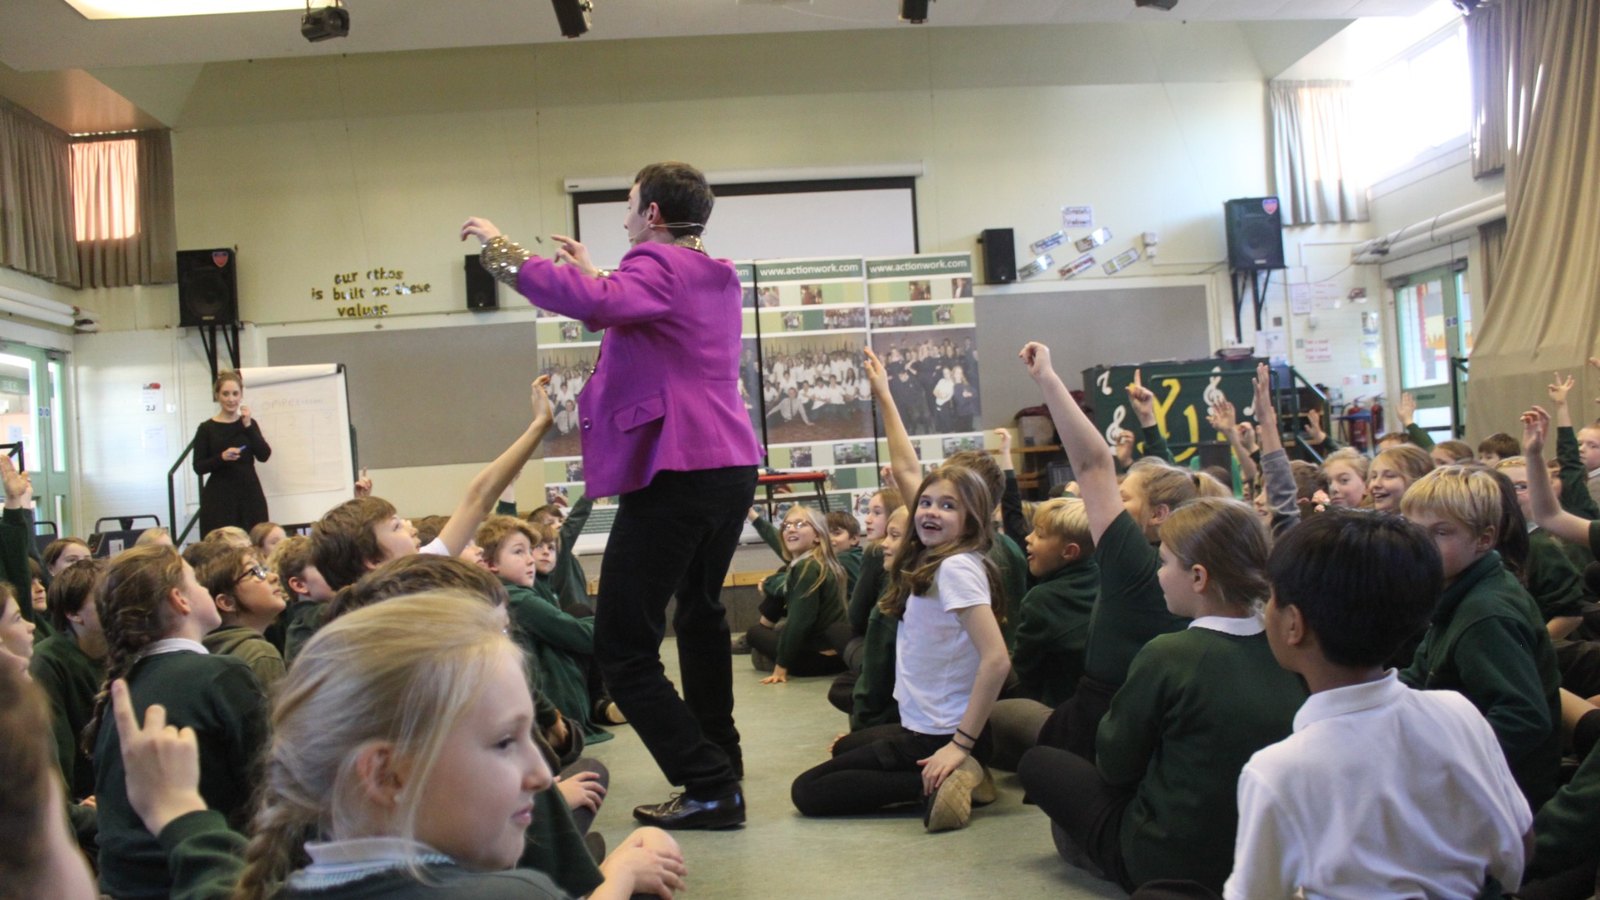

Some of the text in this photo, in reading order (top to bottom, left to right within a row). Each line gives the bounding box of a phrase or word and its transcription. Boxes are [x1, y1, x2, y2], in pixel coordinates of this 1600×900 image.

[760, 263, 859, 276] www.actionwork.com
[869, 259, 967, 273] www.actionwork.com
[311, 288, 324, 300] is
